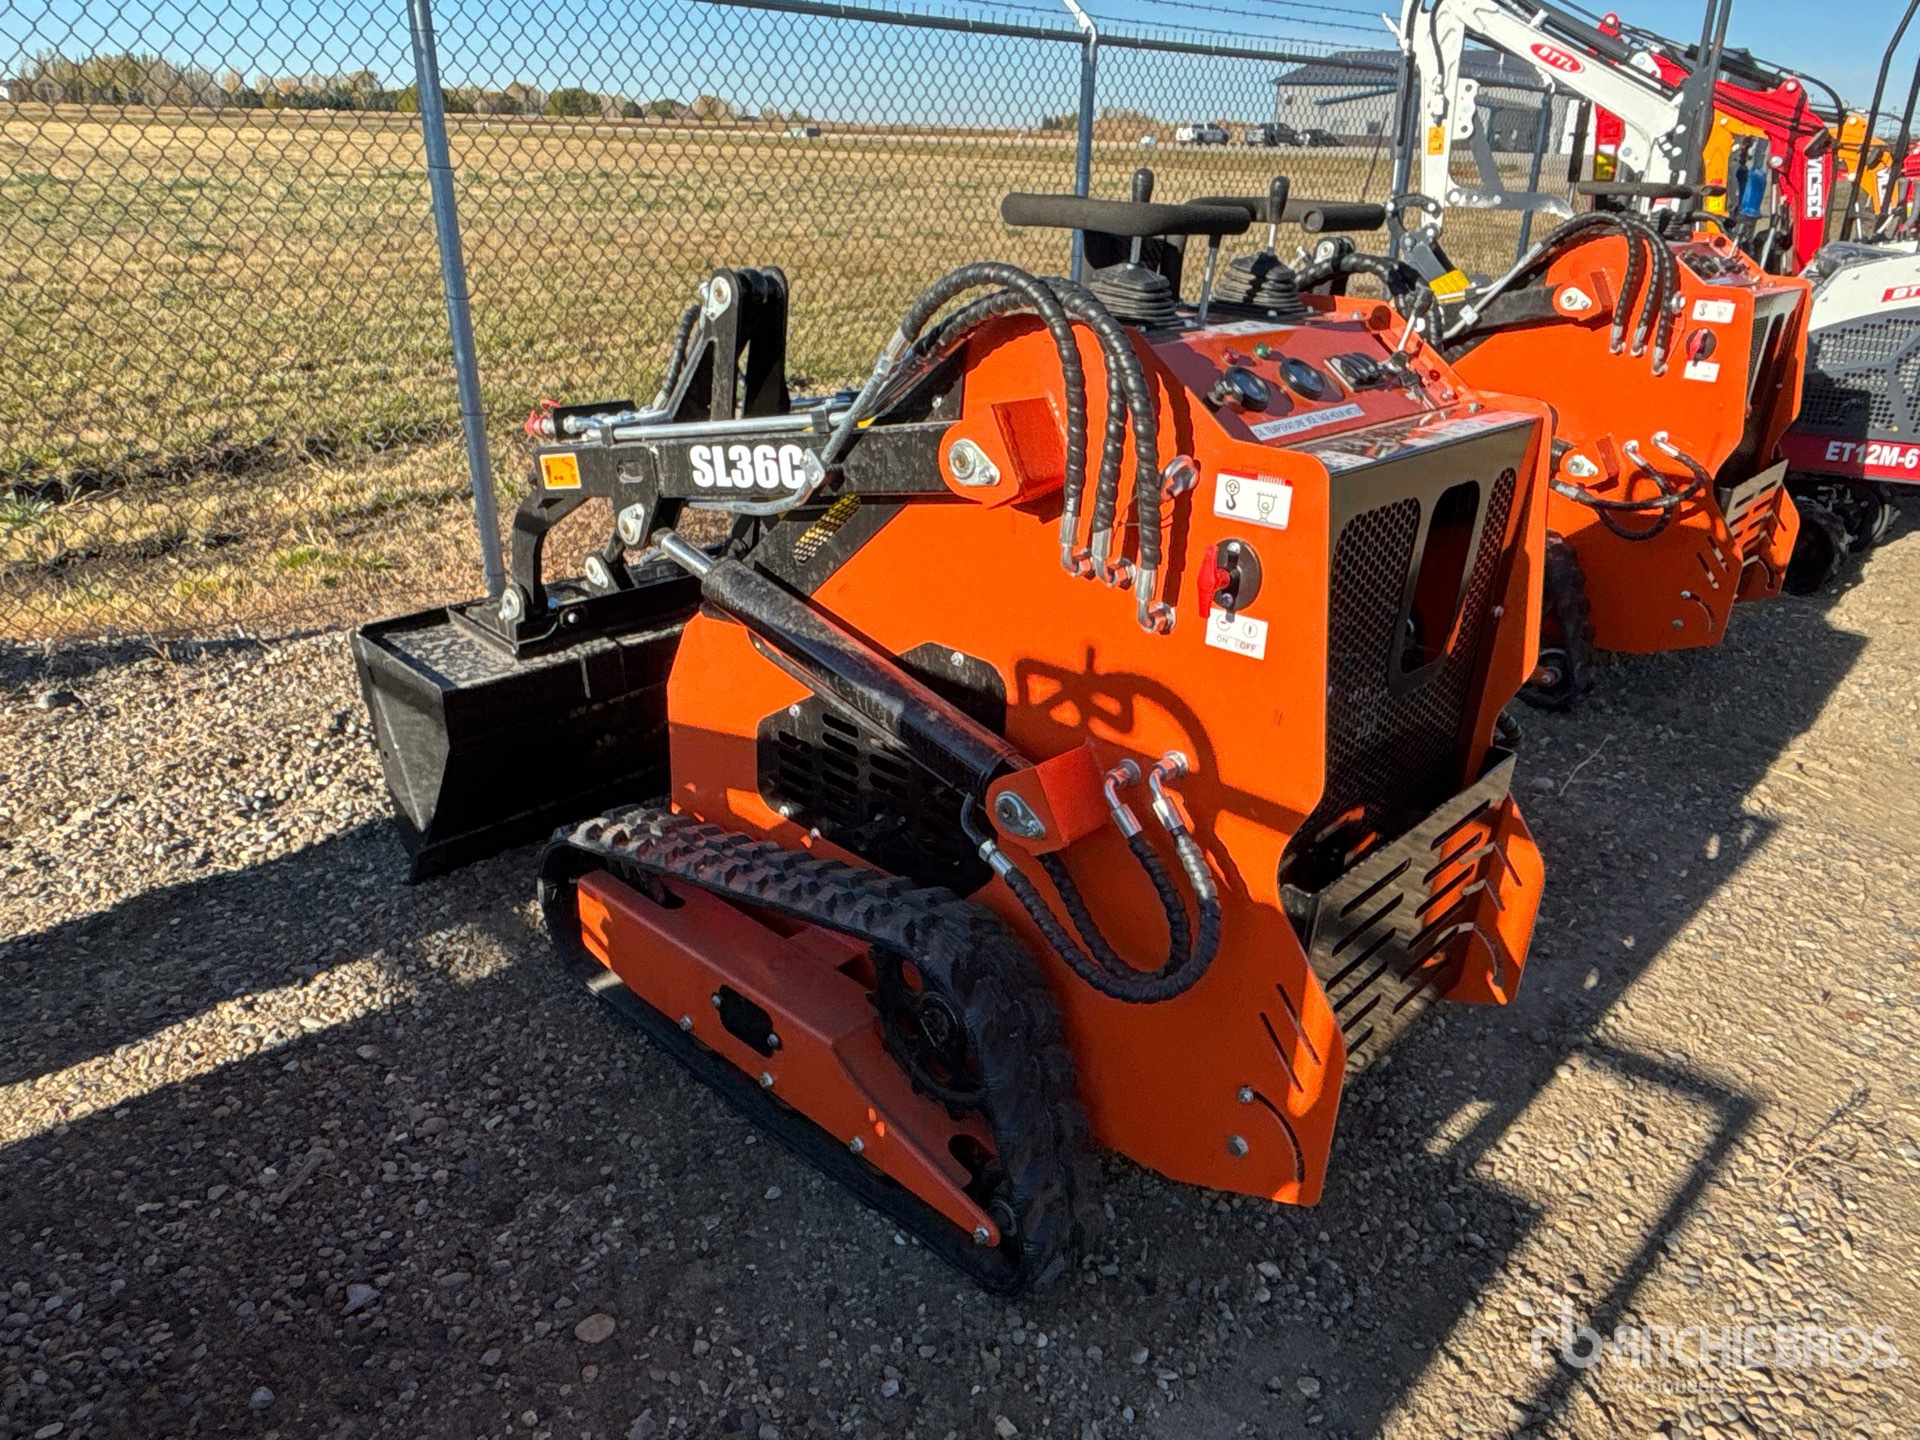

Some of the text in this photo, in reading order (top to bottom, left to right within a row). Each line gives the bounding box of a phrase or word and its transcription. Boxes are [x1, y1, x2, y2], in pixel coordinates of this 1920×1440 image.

[1537, 46, 1574, 71] BTTL
[689, 444, 805, 489] SL36C
[1825, 441, 1919, 469] ET12M-6
[1216, 635, 1257, 652] ON OFF
